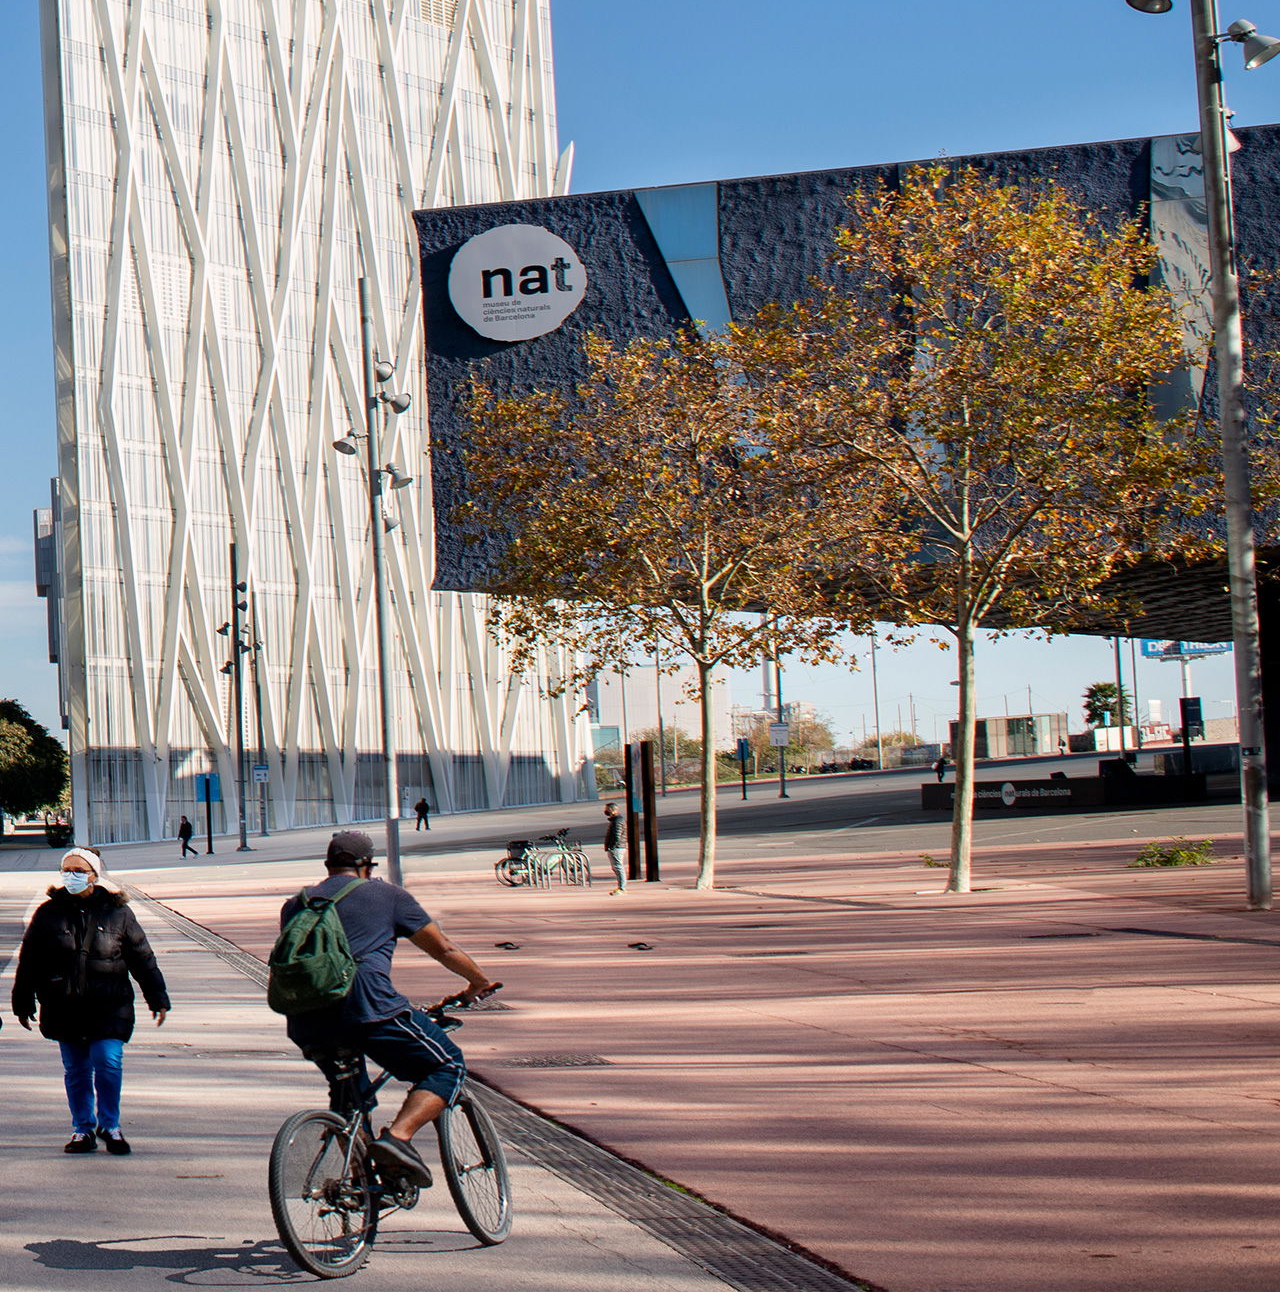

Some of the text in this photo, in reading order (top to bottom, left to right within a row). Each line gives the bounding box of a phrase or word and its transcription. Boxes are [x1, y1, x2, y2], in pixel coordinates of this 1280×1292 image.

[481, 257, 573, 298] nat
[483, 300, 509, 308] museu
[483, 304, 551, 315] ciències naturals
[495, 313, 535, 322] Barcelona
